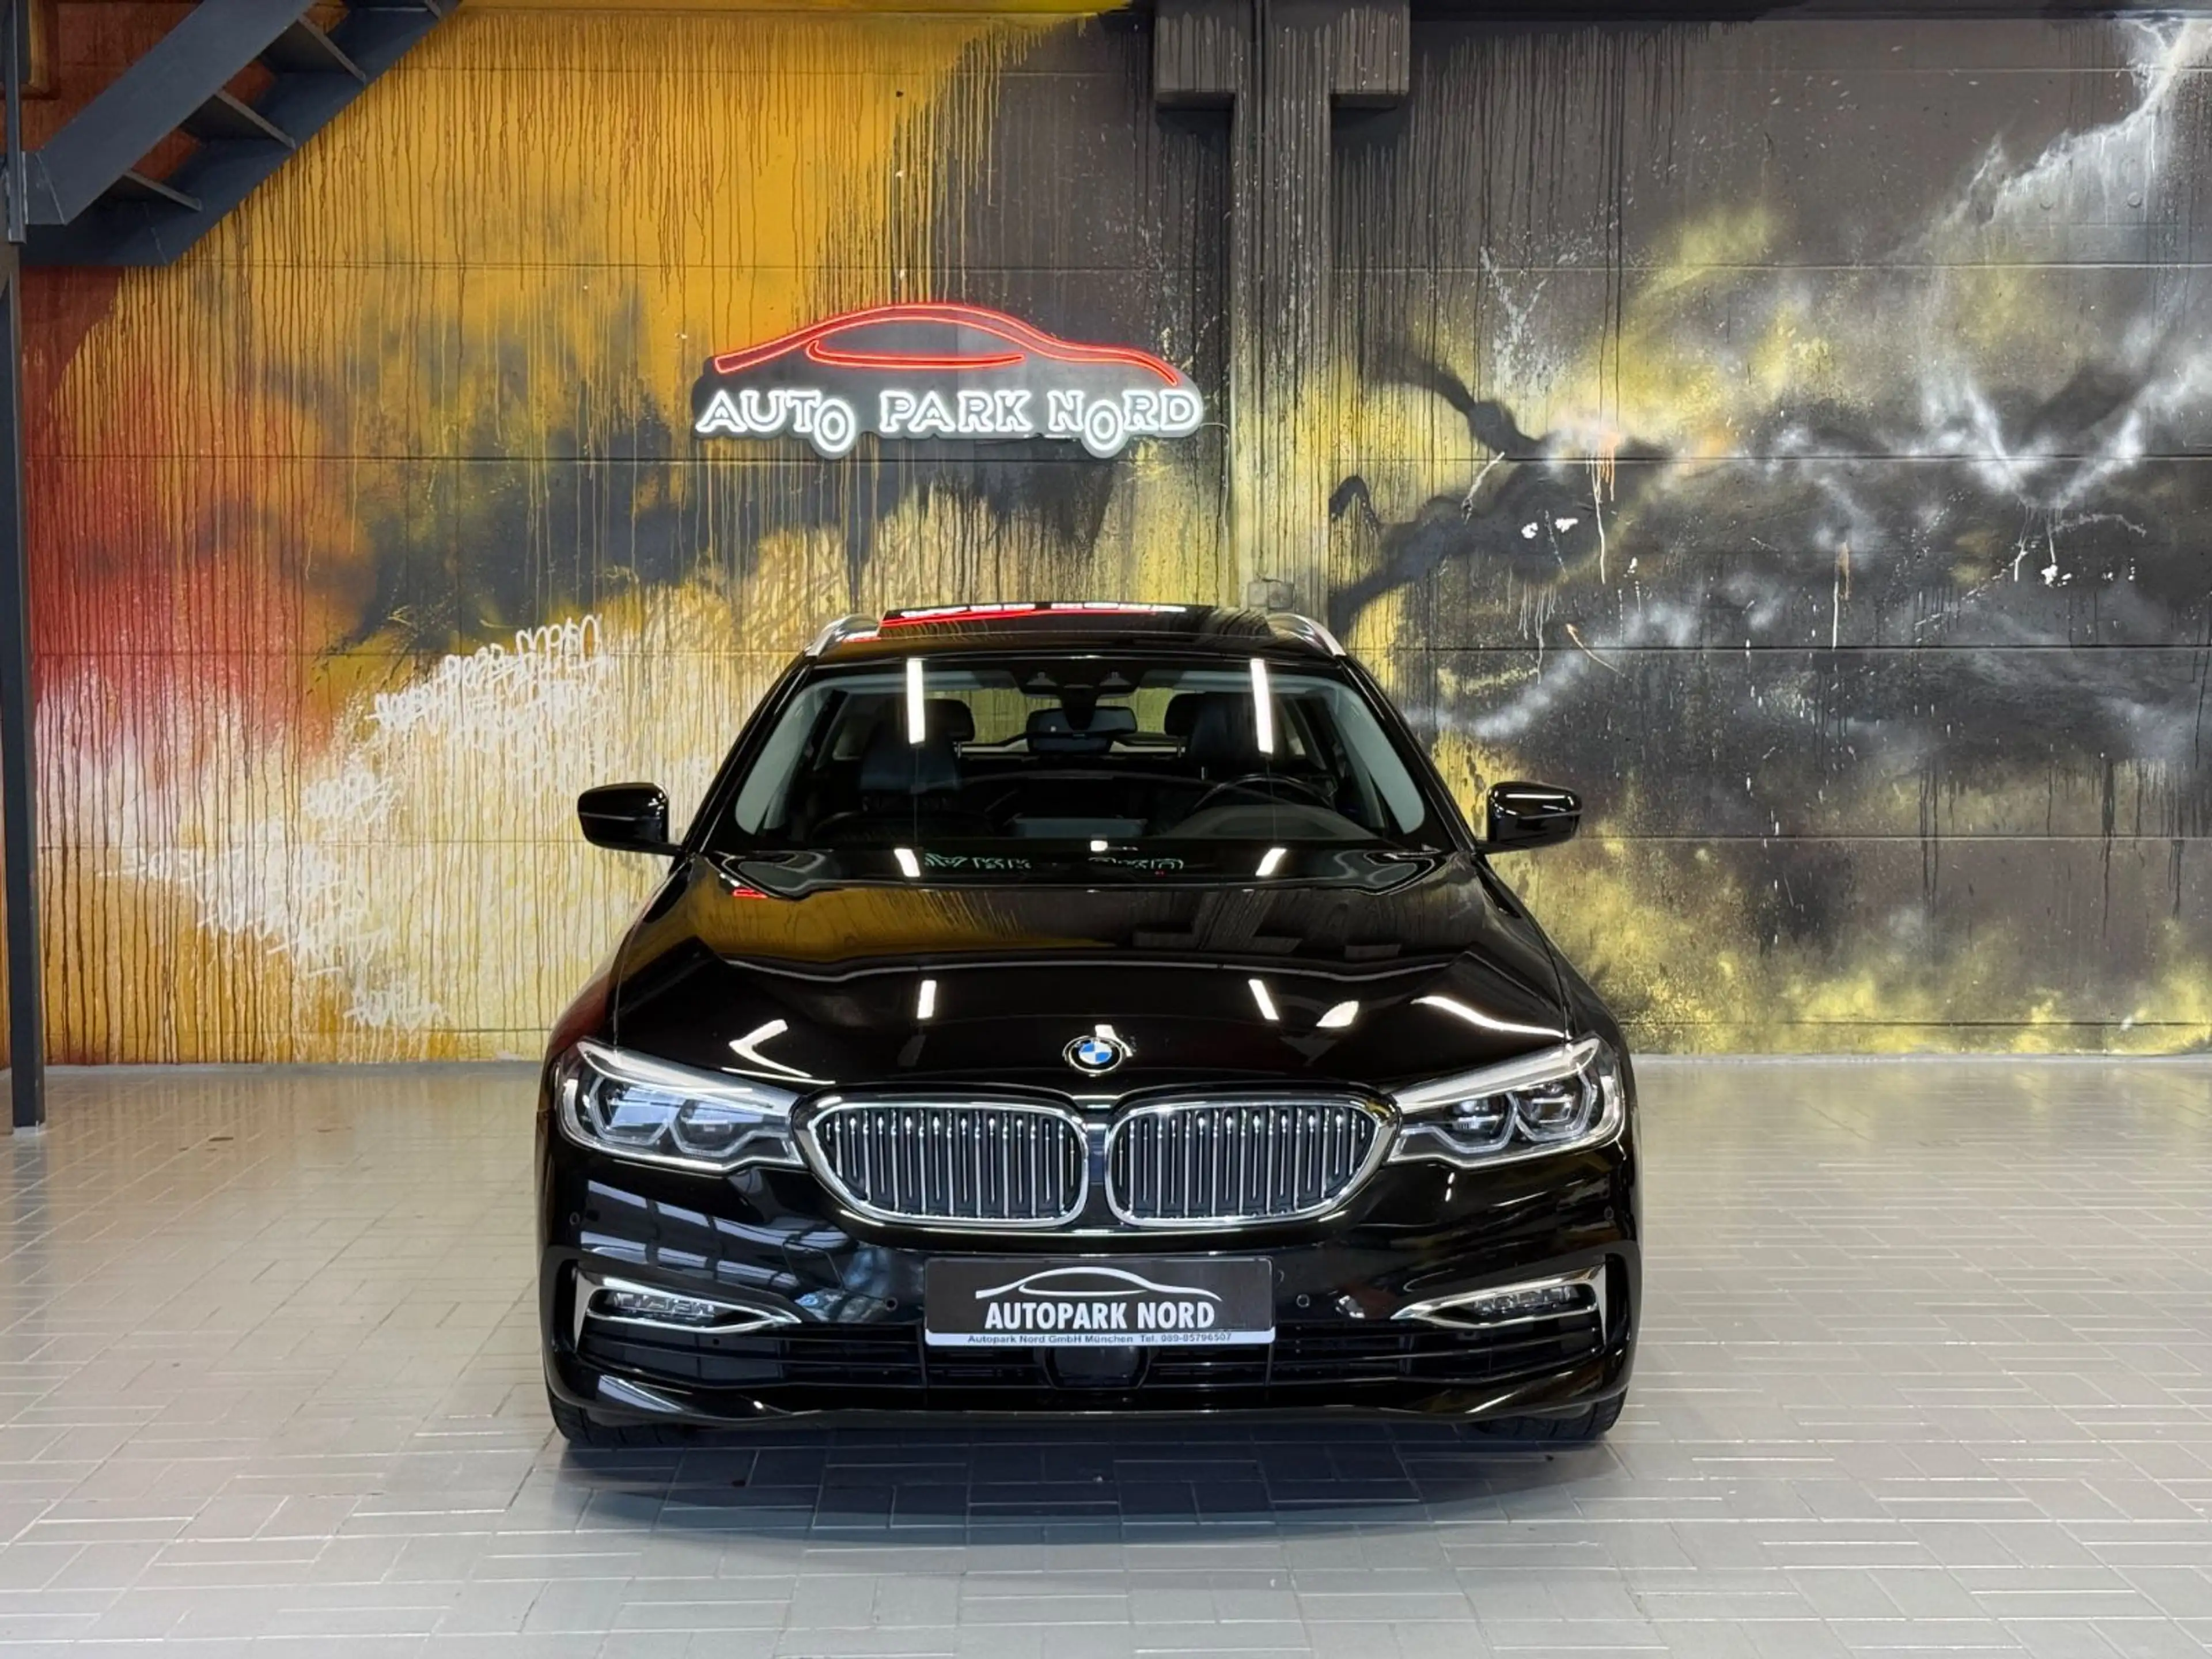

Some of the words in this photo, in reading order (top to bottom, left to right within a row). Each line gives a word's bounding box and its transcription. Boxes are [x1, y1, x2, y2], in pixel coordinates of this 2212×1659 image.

[696, 389, 857, 455] AUTO
[879, 391, 1035, 433] PARK
[1047, 389, 1203, 455] NORD
[984, 1302, 1127, 1330] AUTOPARK
[1137, 1301, 1215, 1329] NORD
[968, 1335, 1016, 1344] Autopark
[1020, 1335, 1045, 1343] Nord
[1048, 1335, 1082, 1343] GmbH
[1085, 1334, 1133, 1343] München
[1141, 1334, 1158, 1343] Tel.
